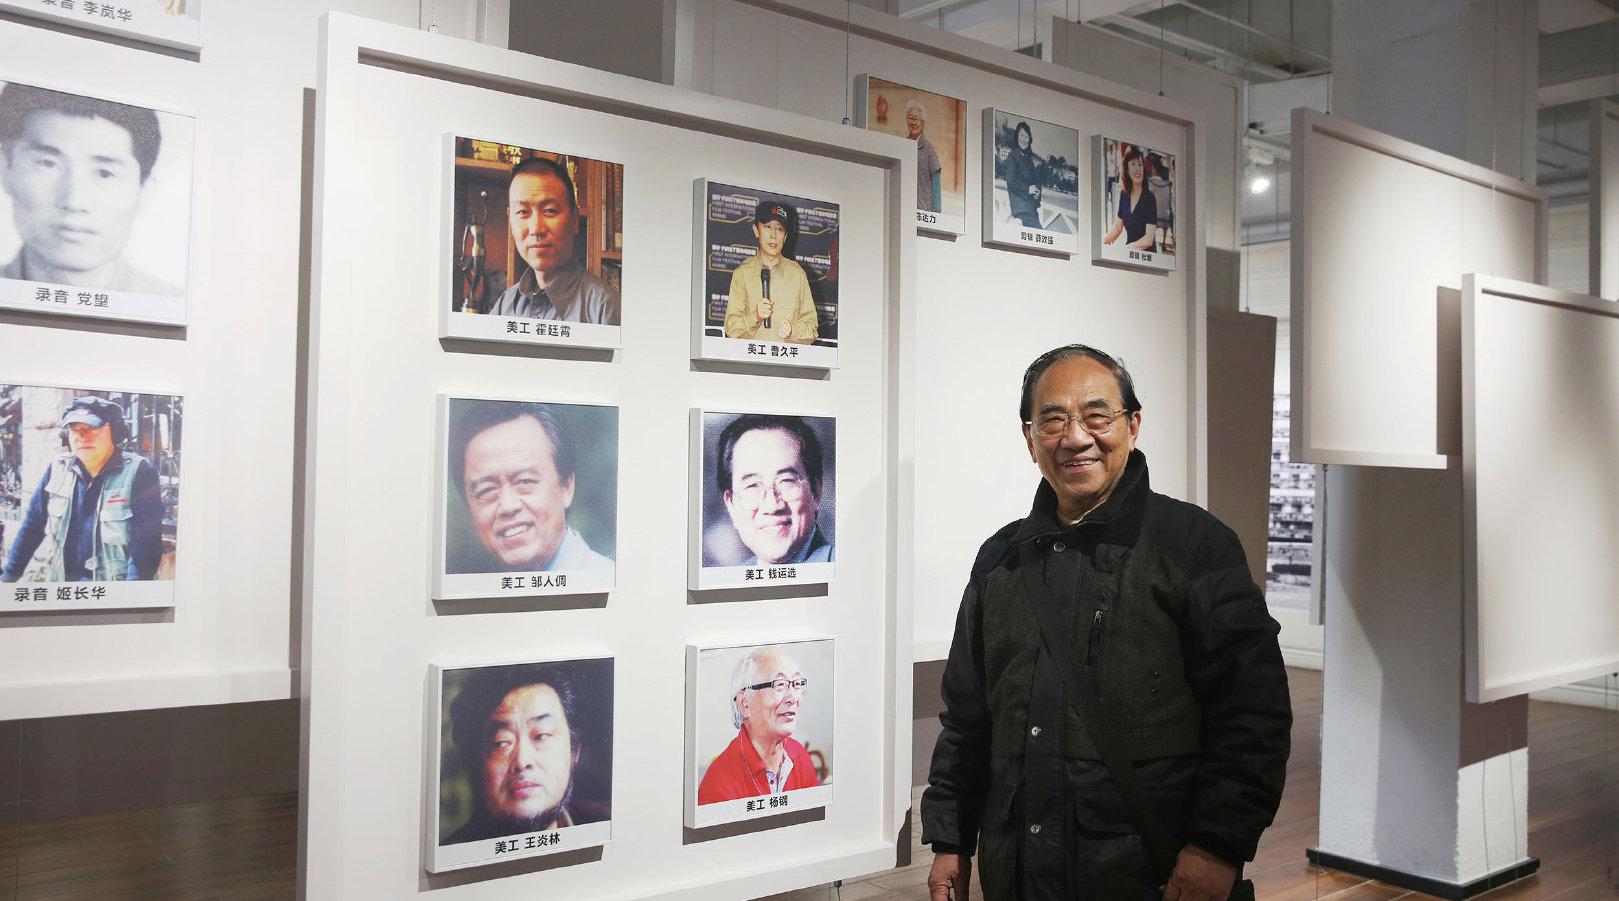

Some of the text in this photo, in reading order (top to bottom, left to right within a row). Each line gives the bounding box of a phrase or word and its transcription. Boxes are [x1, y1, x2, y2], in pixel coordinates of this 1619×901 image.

[84, 1, 133, 22] 李岚华
[35, 287, 109, 308] 录音 党望
[506, 320, 571, 338] 美工 霍廷霄
[747, 343, 799, 358] 美工 曹久平
[745, 567, 797, 581] 美工 钱运选
[501, 576, 525, 589] 美工
[14, 586, 107, 602] 录音 姬长华
[746, 799, 765, 812] 美工
[494, 832, 561, 854] 美工 王炎林
